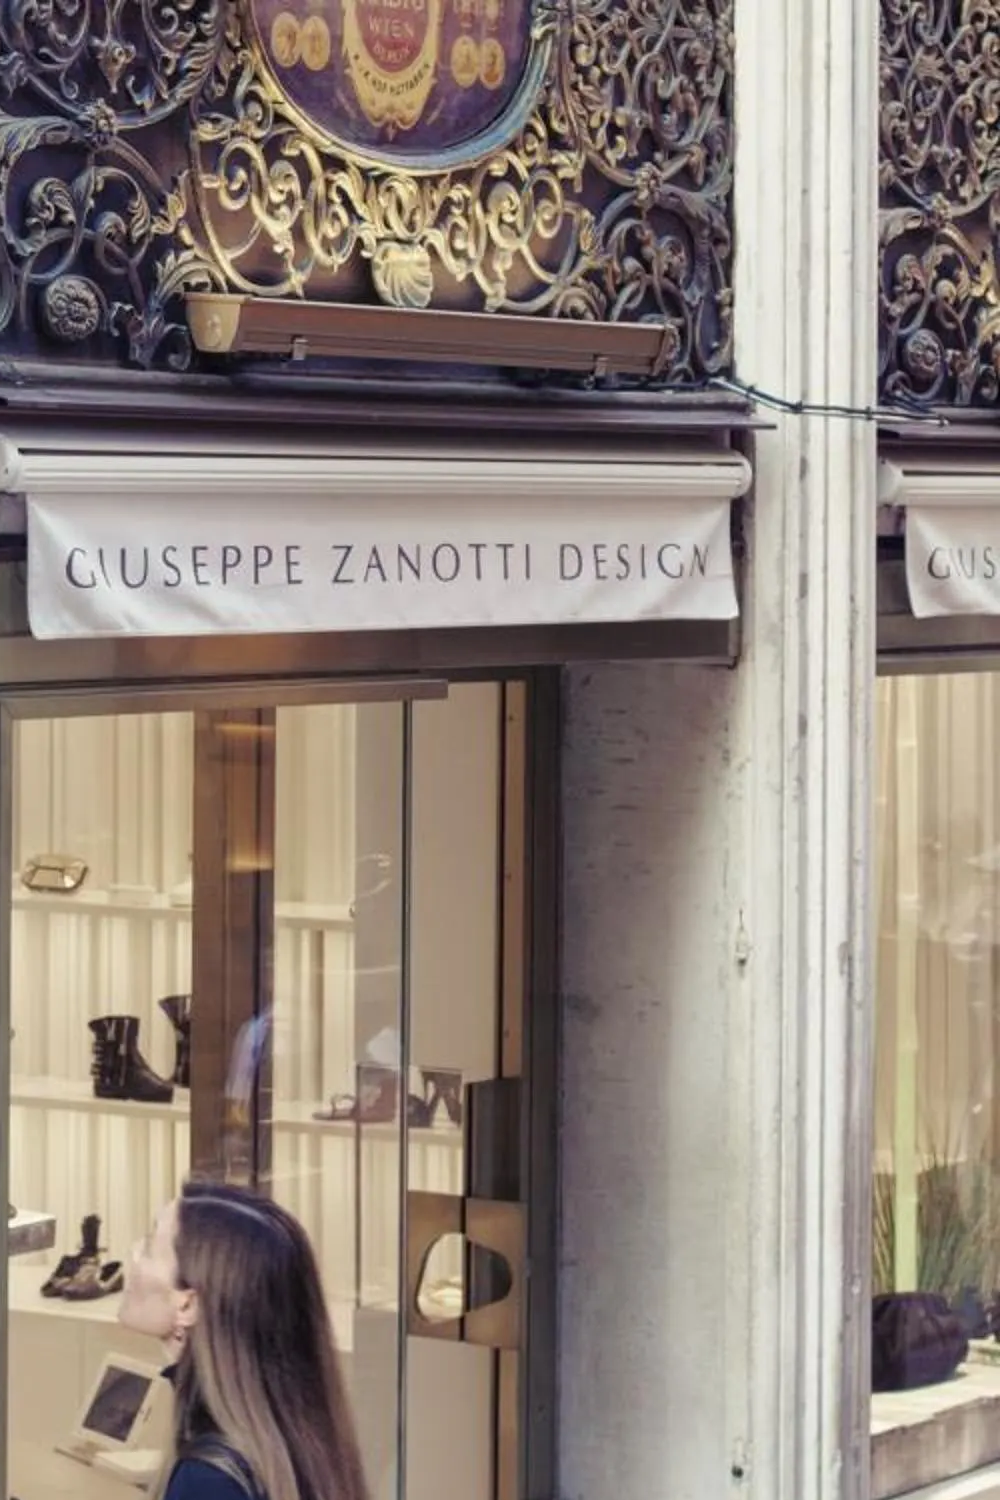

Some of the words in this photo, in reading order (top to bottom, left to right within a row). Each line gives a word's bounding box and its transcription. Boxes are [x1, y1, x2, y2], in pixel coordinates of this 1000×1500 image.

[65, 544, 304, 589] GIUSEPPE
[331, 543, 532, 584] ZANOTTI
[558, 543, 710, 582] DESIGN
